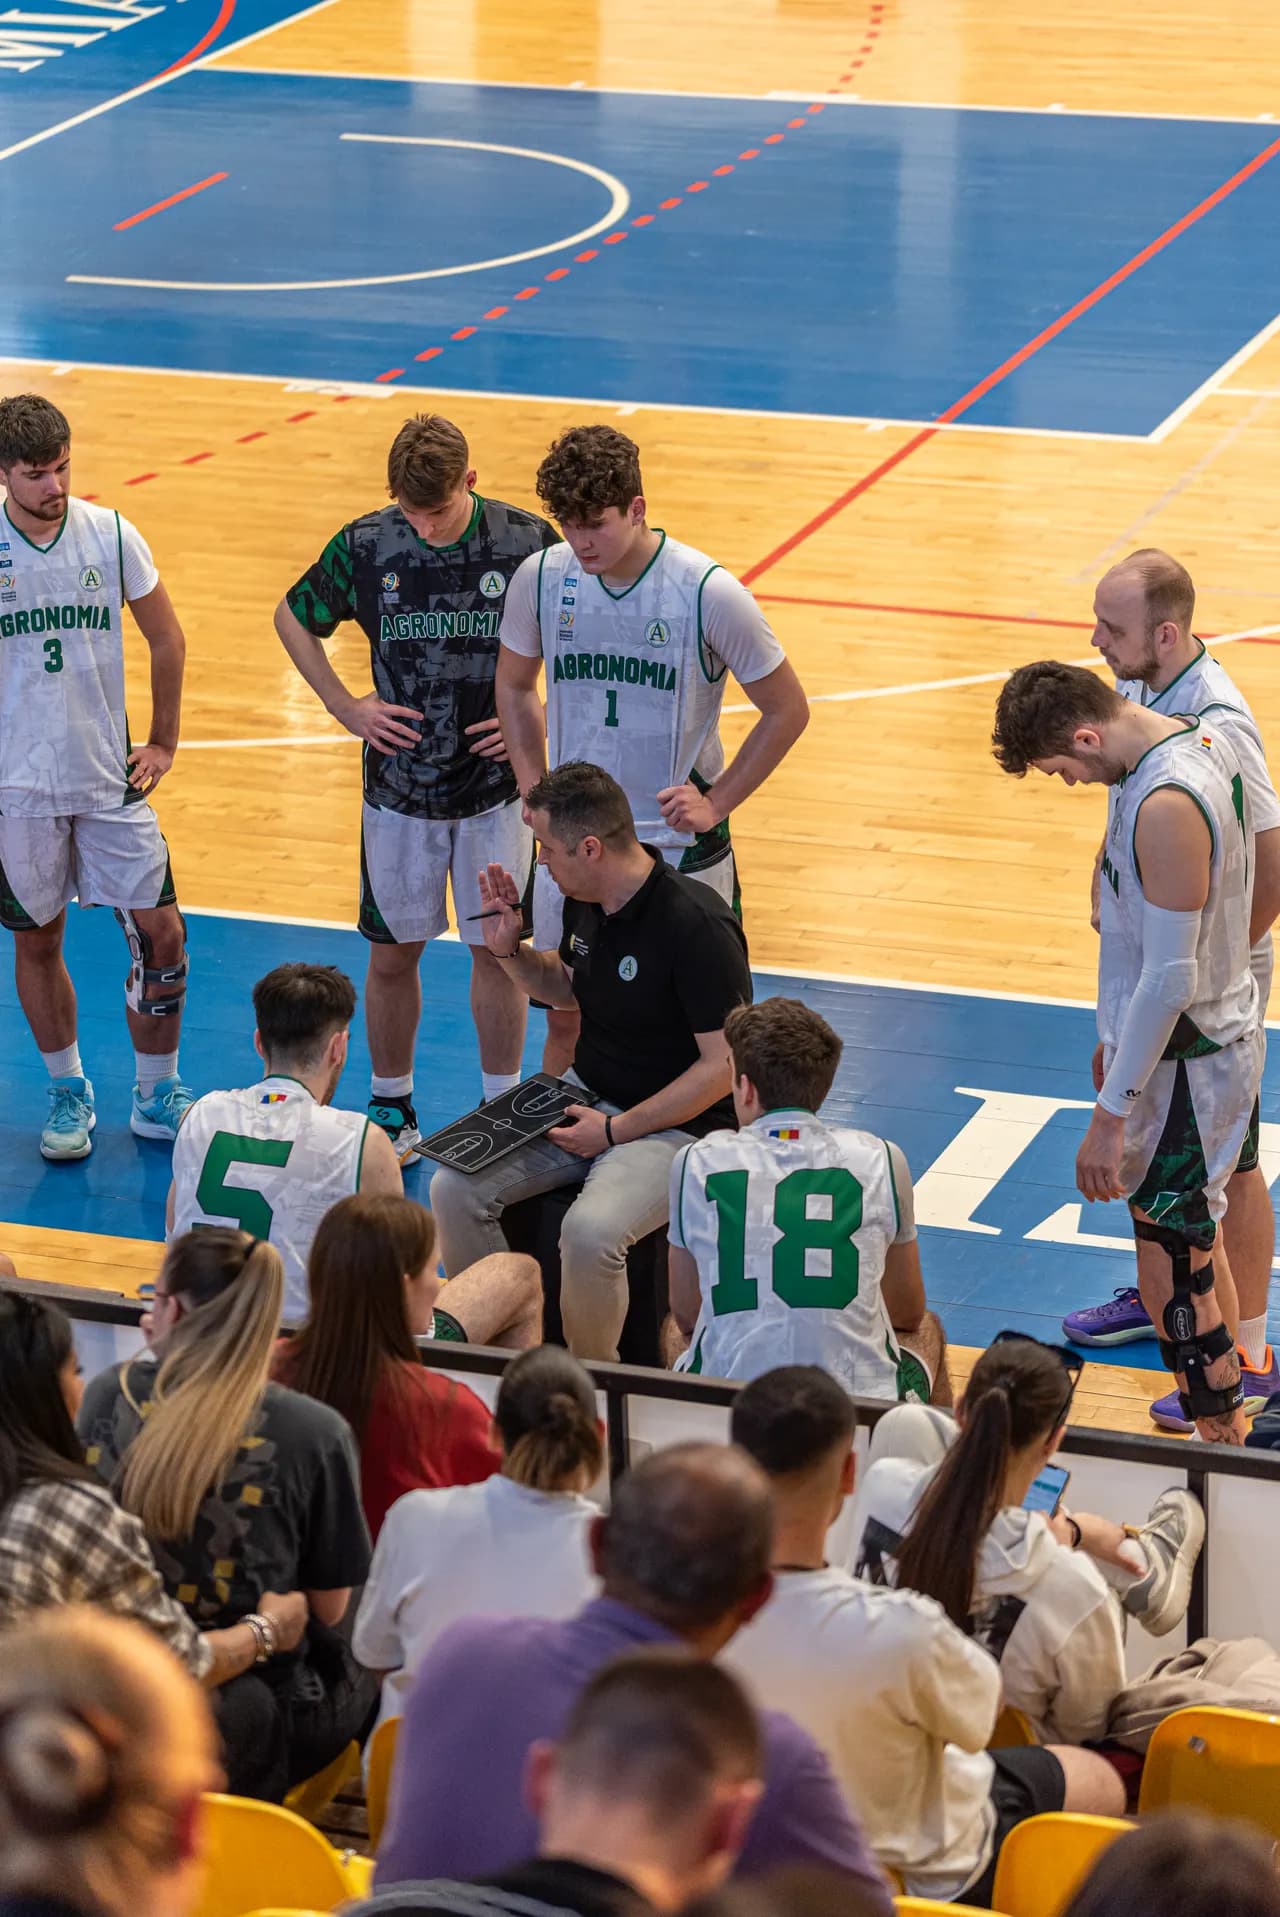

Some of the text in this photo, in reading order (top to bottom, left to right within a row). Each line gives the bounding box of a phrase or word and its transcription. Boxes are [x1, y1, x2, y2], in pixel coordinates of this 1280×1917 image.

[0, 605, 111, 640] GRONOMIA
[381, 610, 501, 641] AGRONOMI
[43, 638, 64, 673] 3
[553, 653, 677, 693] AGRONOMIA
[604, 689, 619, 727] 1
[191, 1130, 294, 1241] 5
[705, 1167, 863, 1317] 18
